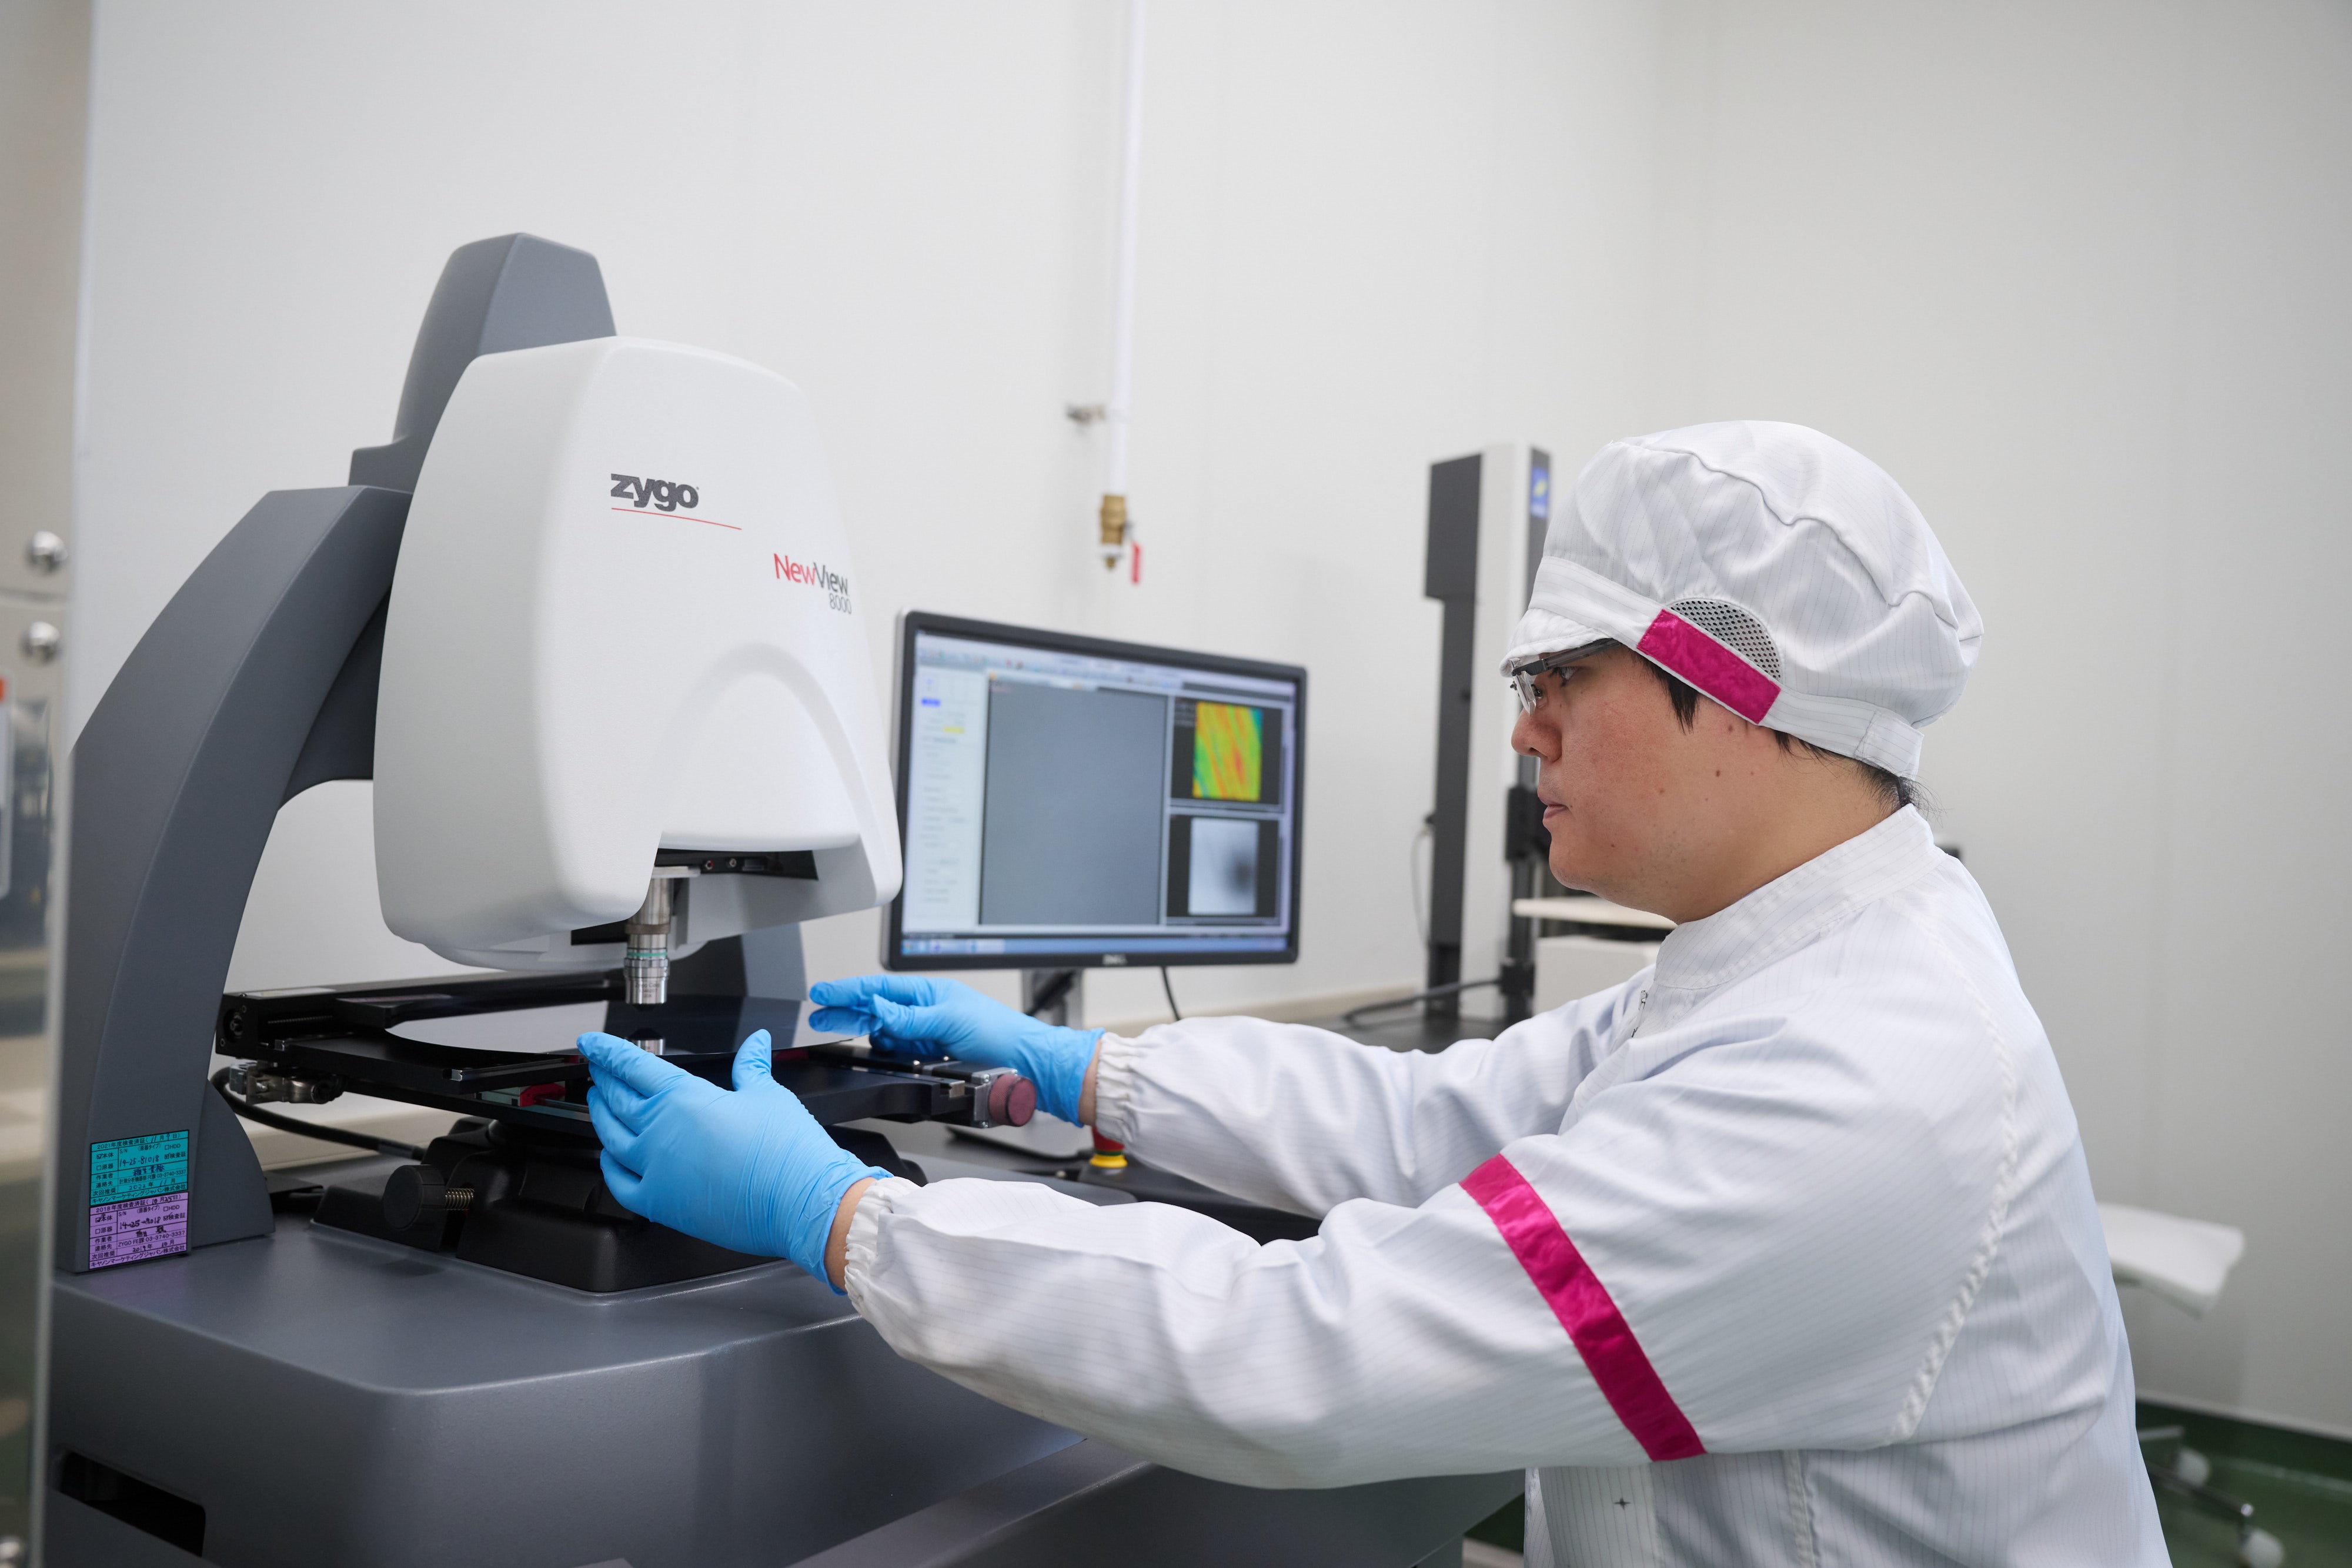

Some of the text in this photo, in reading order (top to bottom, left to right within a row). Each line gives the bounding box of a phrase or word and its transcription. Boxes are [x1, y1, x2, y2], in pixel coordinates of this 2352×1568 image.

[611, 473, 699, 511] zygo
[774, 553, 848, 595] NewView
[830, 593, 852, 614] 8000
[93, 1188, 116, 1196] 次回推奨
[95, 1236, 112, 1244] 作業者
[146, 1231, 185, 1242] 03-3740-3337
[95, 1243, 112, 1252] 連絡先
[92, 1250, 115, 1259] 次回推奨
